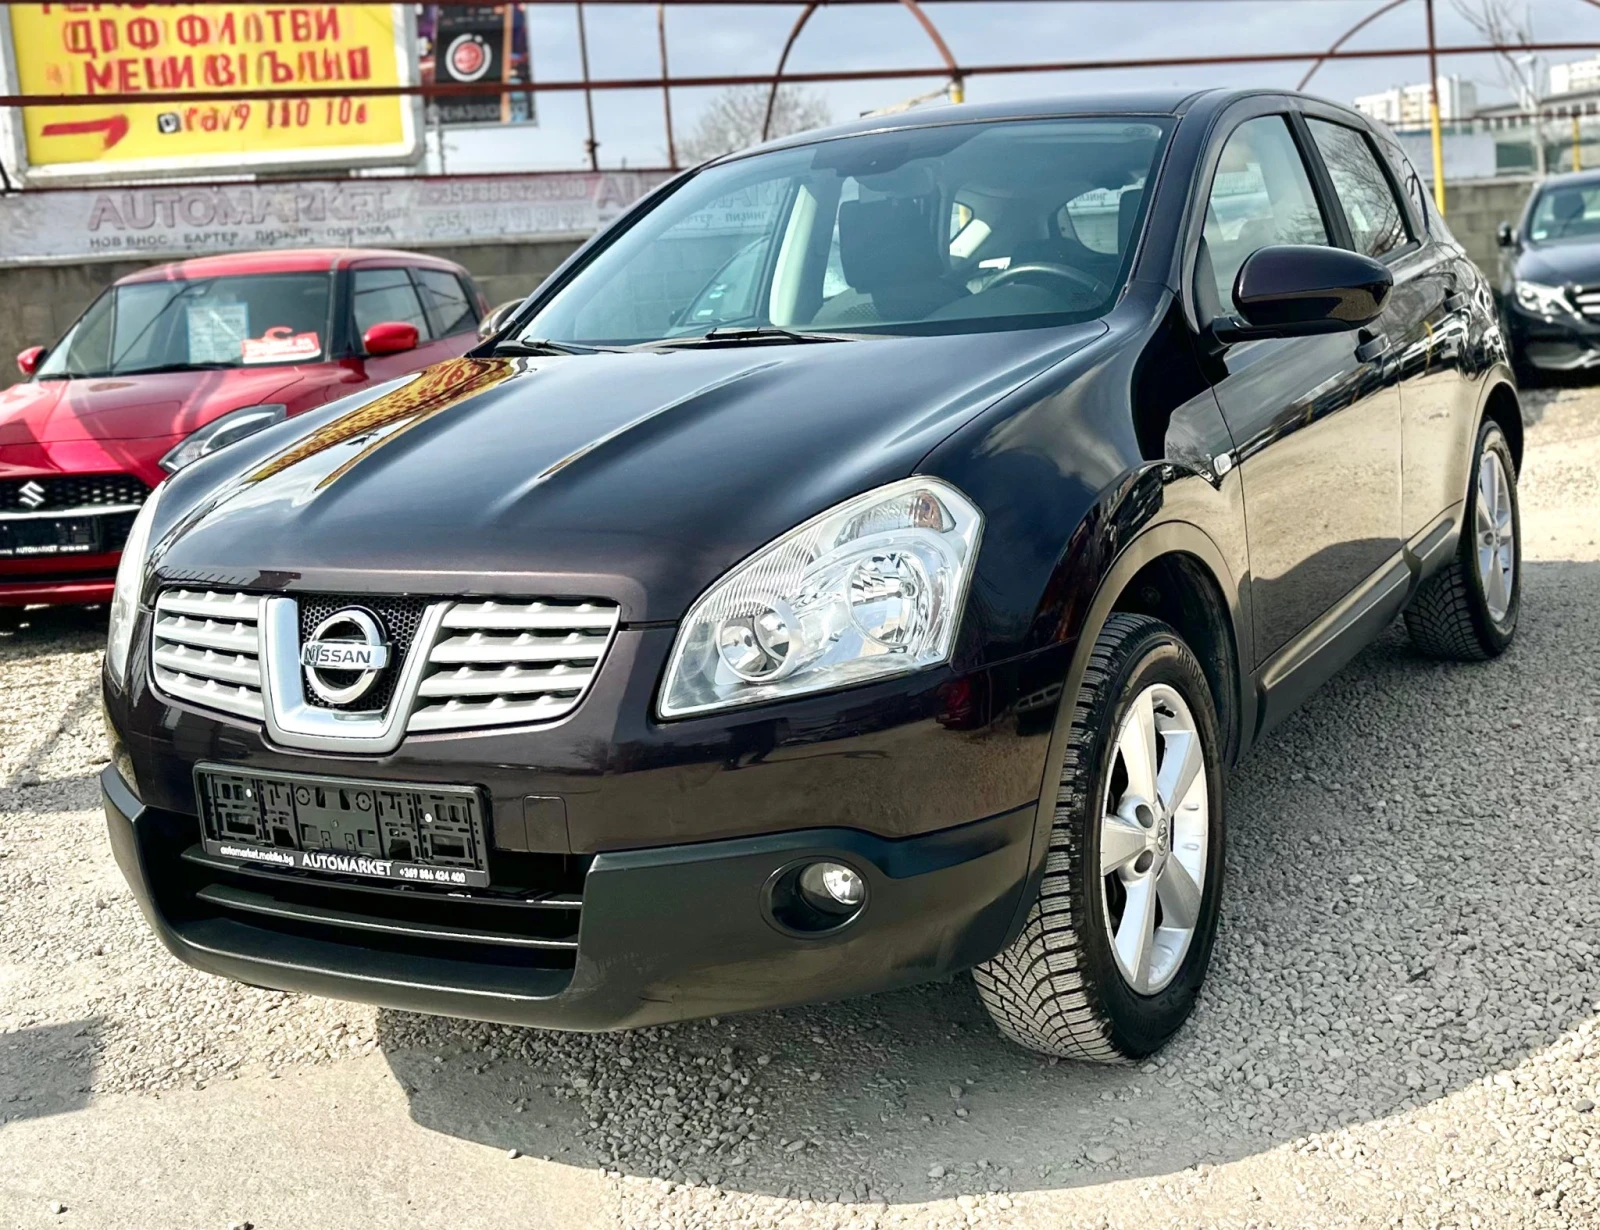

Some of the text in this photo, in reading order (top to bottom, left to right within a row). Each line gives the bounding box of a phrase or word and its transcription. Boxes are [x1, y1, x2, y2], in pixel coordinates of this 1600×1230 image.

[88, 183, 391, 231] AUTOMARKET
[184, 231, 239, 244] БАРТЕР
[304, 645, 371, 664] NISSAN
[220, 845, 295, 867] automarket.mobile.bg
[302, 853, 393, 877] AUTOMARKET
[435, 870, 450, 882] 424
[450, 871, 466, 883] 400
